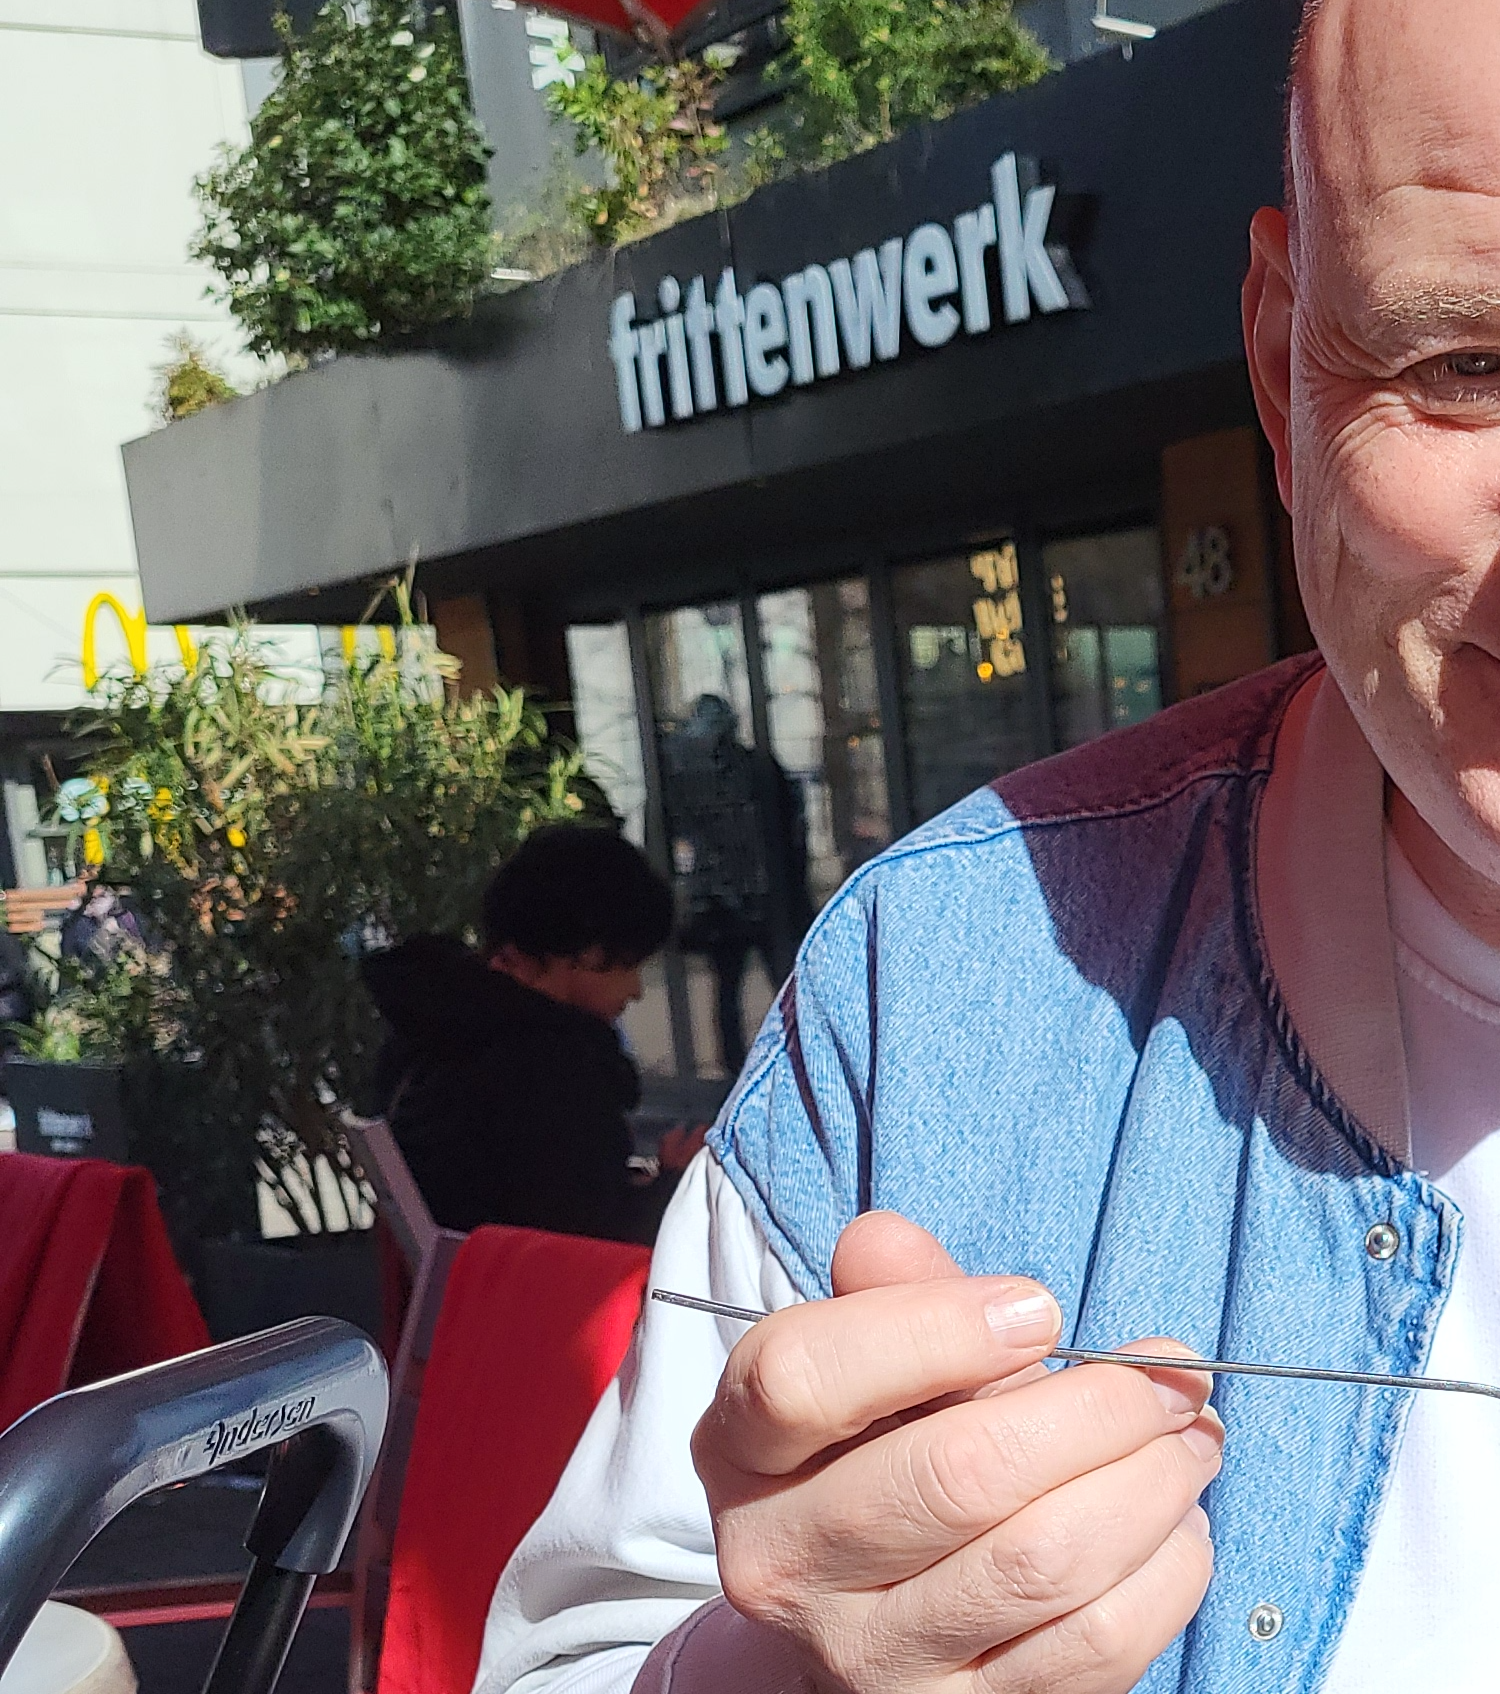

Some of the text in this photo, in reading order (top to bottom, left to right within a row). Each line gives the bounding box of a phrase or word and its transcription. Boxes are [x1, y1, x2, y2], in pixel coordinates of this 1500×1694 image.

[608, 150, 1070, 433] frittenwerk
[1173, 526, 1231, 598] 48
[202, 1396, 316, 1466] Andersen
